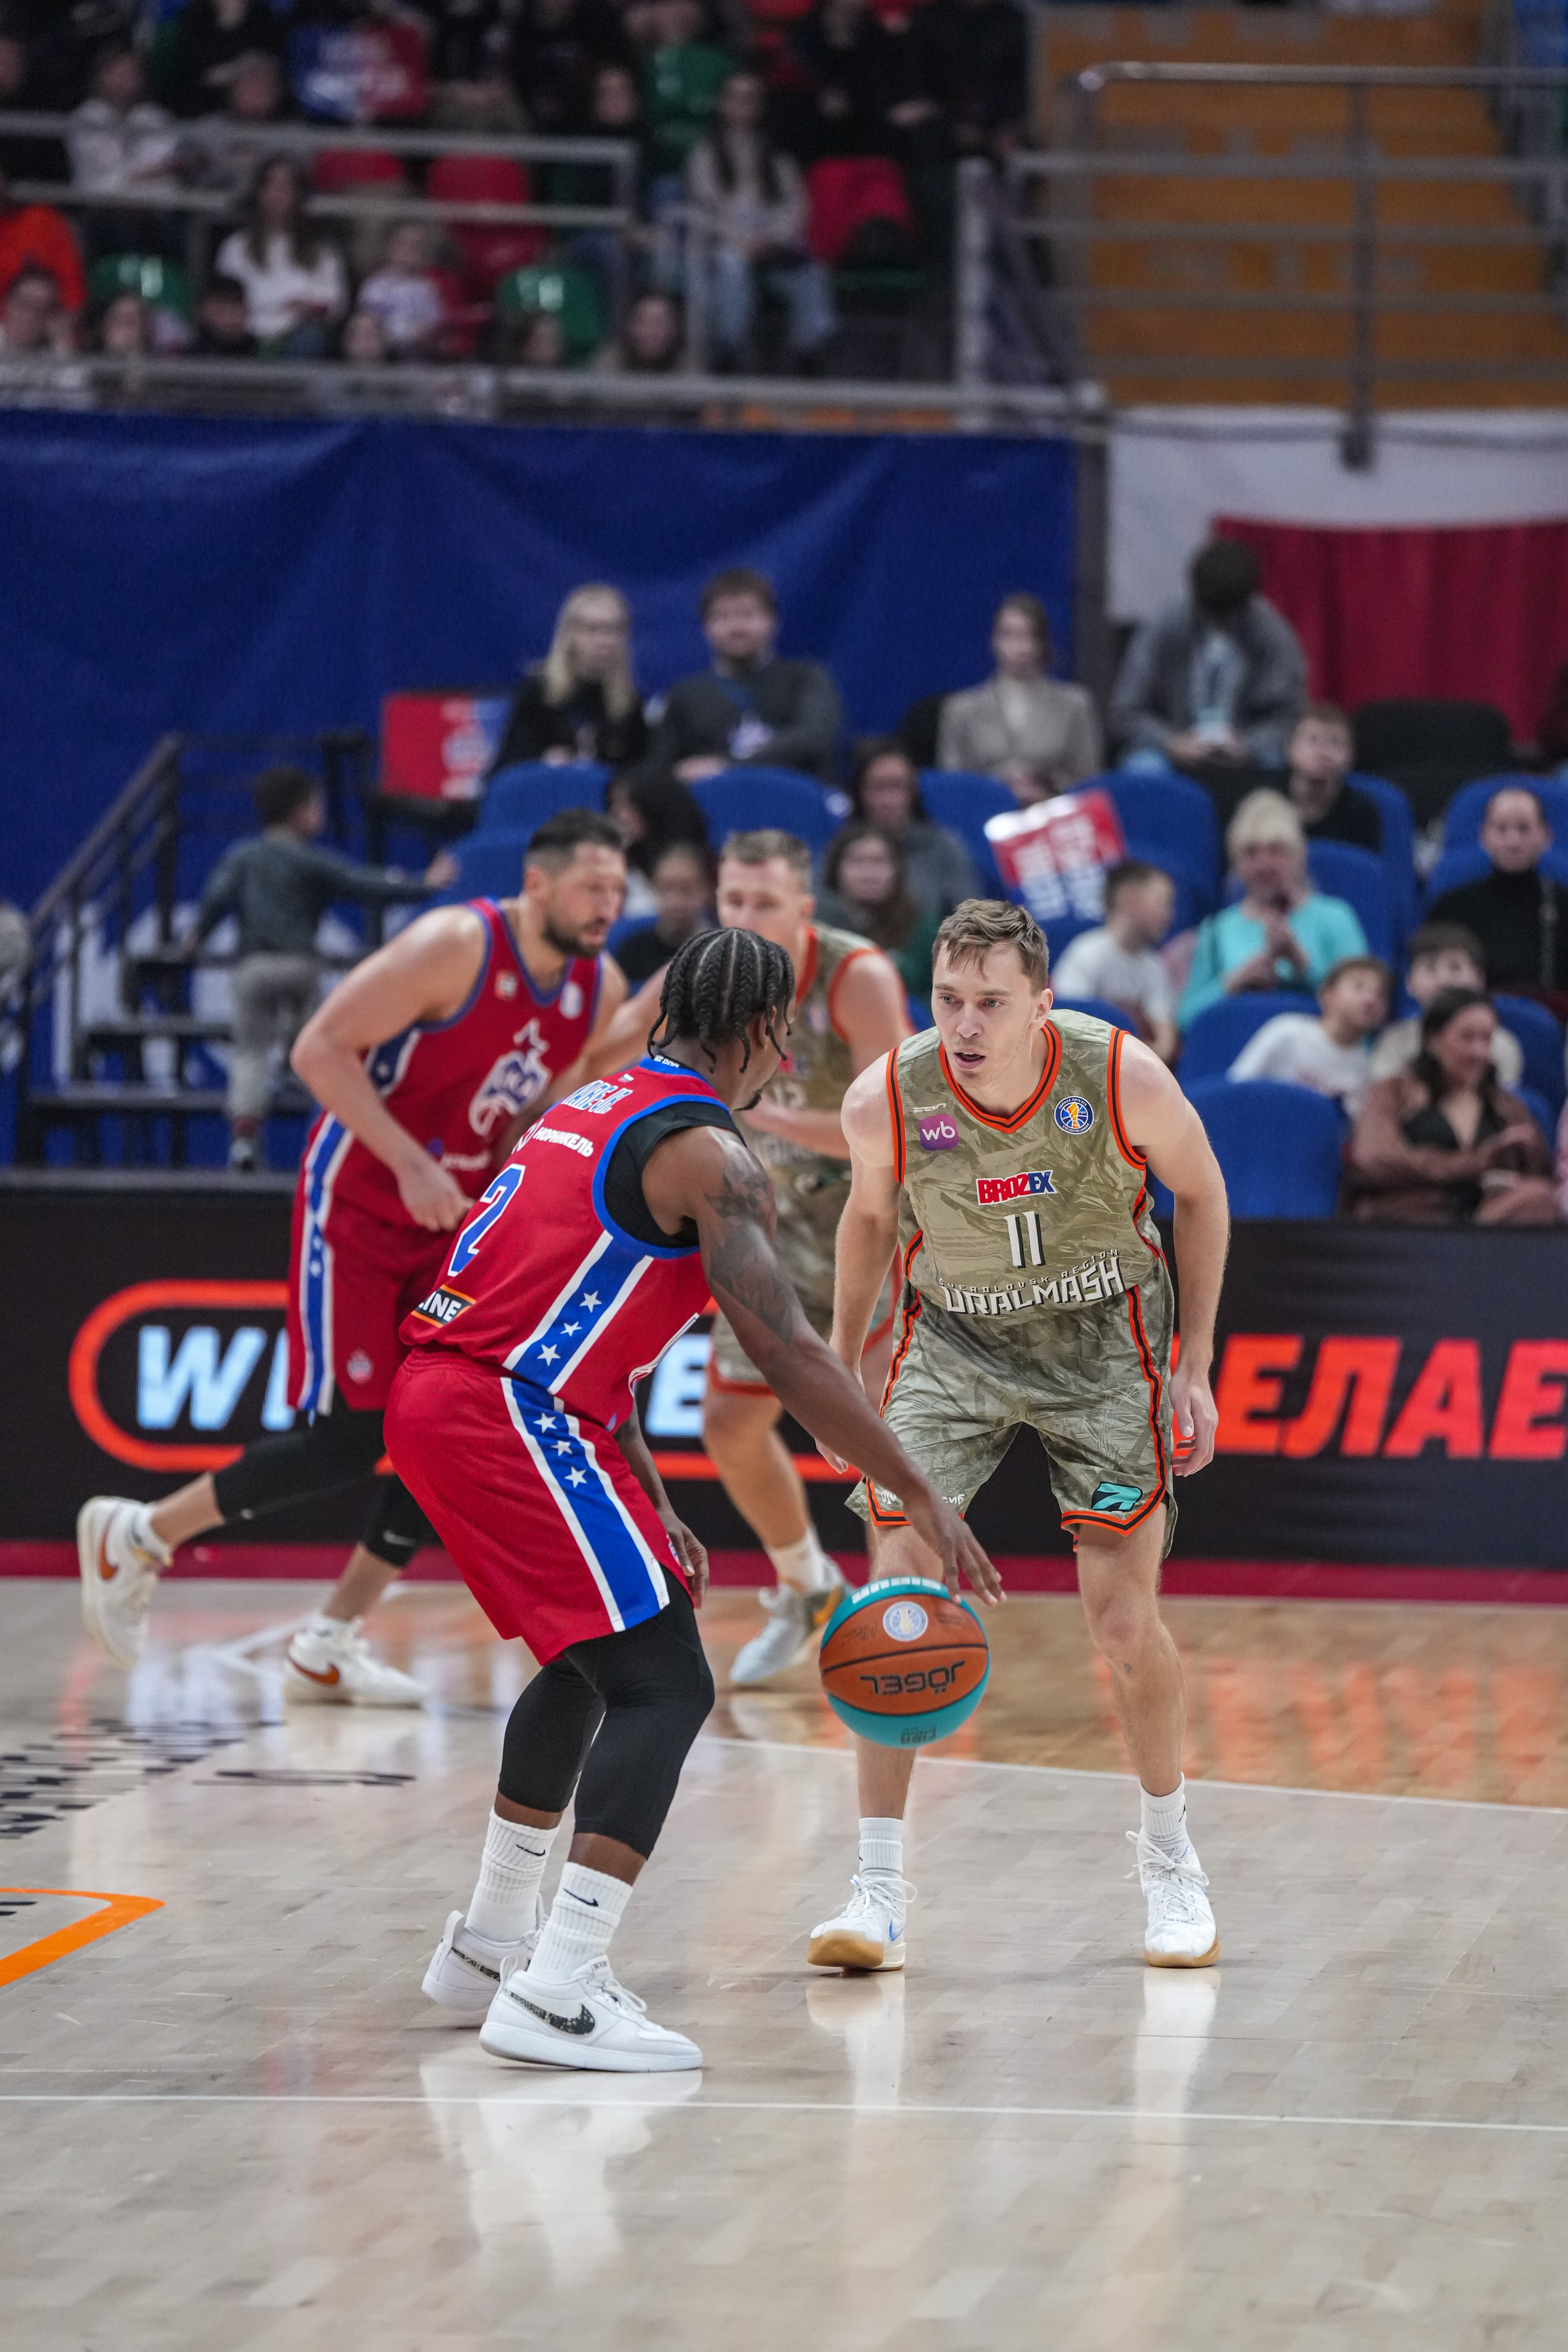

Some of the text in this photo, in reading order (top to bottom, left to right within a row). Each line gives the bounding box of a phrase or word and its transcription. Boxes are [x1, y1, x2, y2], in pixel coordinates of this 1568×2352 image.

[532, 1126, 594, 1158] НОРНИКЕЛЬ
[921, 1121, 956, 1140] wb
[976, 1170, 1057, 1205] BROZEX
[447, 1163, 526, 1278] 2
[1003, 1211, 1045, 1268] 11
[938, 1249, 1119, 1293] SVERDLOVSK REGION
[940, 1256, 1125, 1316] URALMASH
[418, 1291, 462, 1322] INE
[1170, 1332, 1568, 1460] ЕЛАЕ
[859, 1660, 965, 1695] JÖGEL
